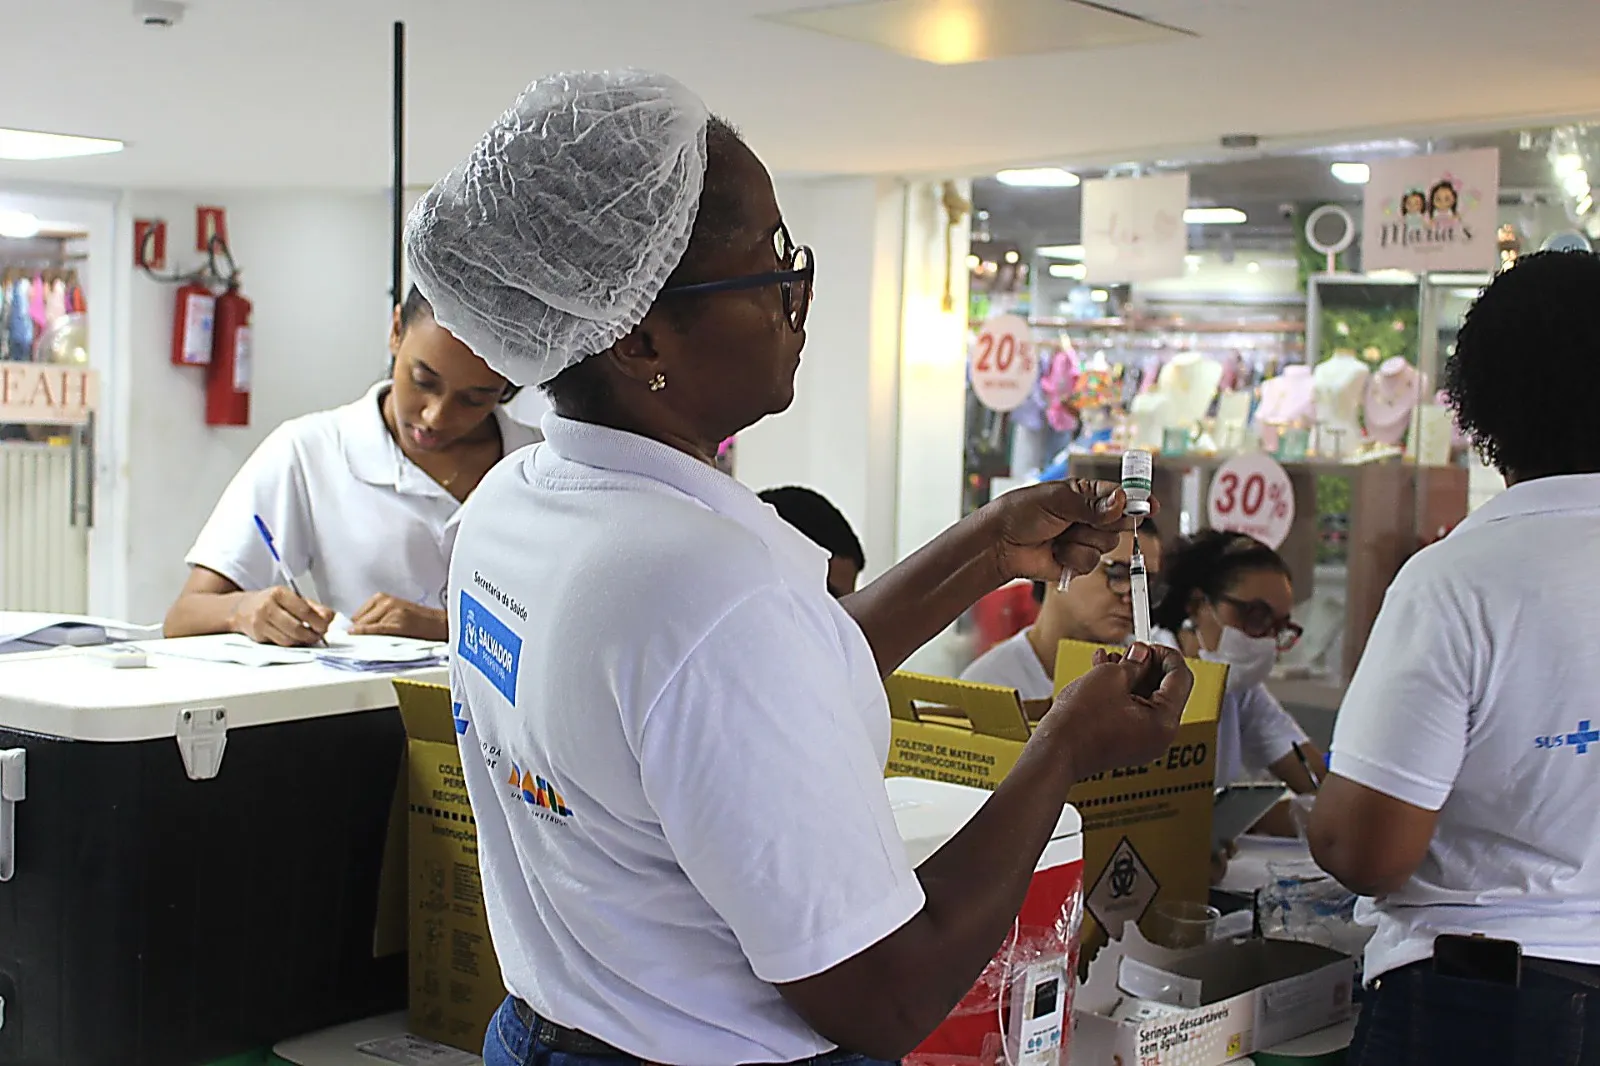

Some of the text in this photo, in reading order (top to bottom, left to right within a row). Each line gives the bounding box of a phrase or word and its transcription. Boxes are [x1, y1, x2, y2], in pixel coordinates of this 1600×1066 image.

[2, 368, 88, 406] EAH
[1216, 472, 1288, 519] 30%
[474, 571, 528, 621] Secretaria da Saúde
[478, 626, 513, 673] SALVADOR
[895, 738, 995, 766] COLETOR DE MATERIAIS
[1166, 742, 1206, 770] ECO
[1535, 735, 1563, 749] SUS
[438, 764, 463, 778] COLE
[888, 762, 936, 780] RECIPIENTE
[900, 751, 990, 776] PERFUROCORTANTES
[1140, 1022, 1177, 1043] Seringas
[1179, 1007, 1229, 1031] descartáveis
[1140, 1041, 1158, 1055] sem
[1160, 1032, 1188, 1051] agulha
